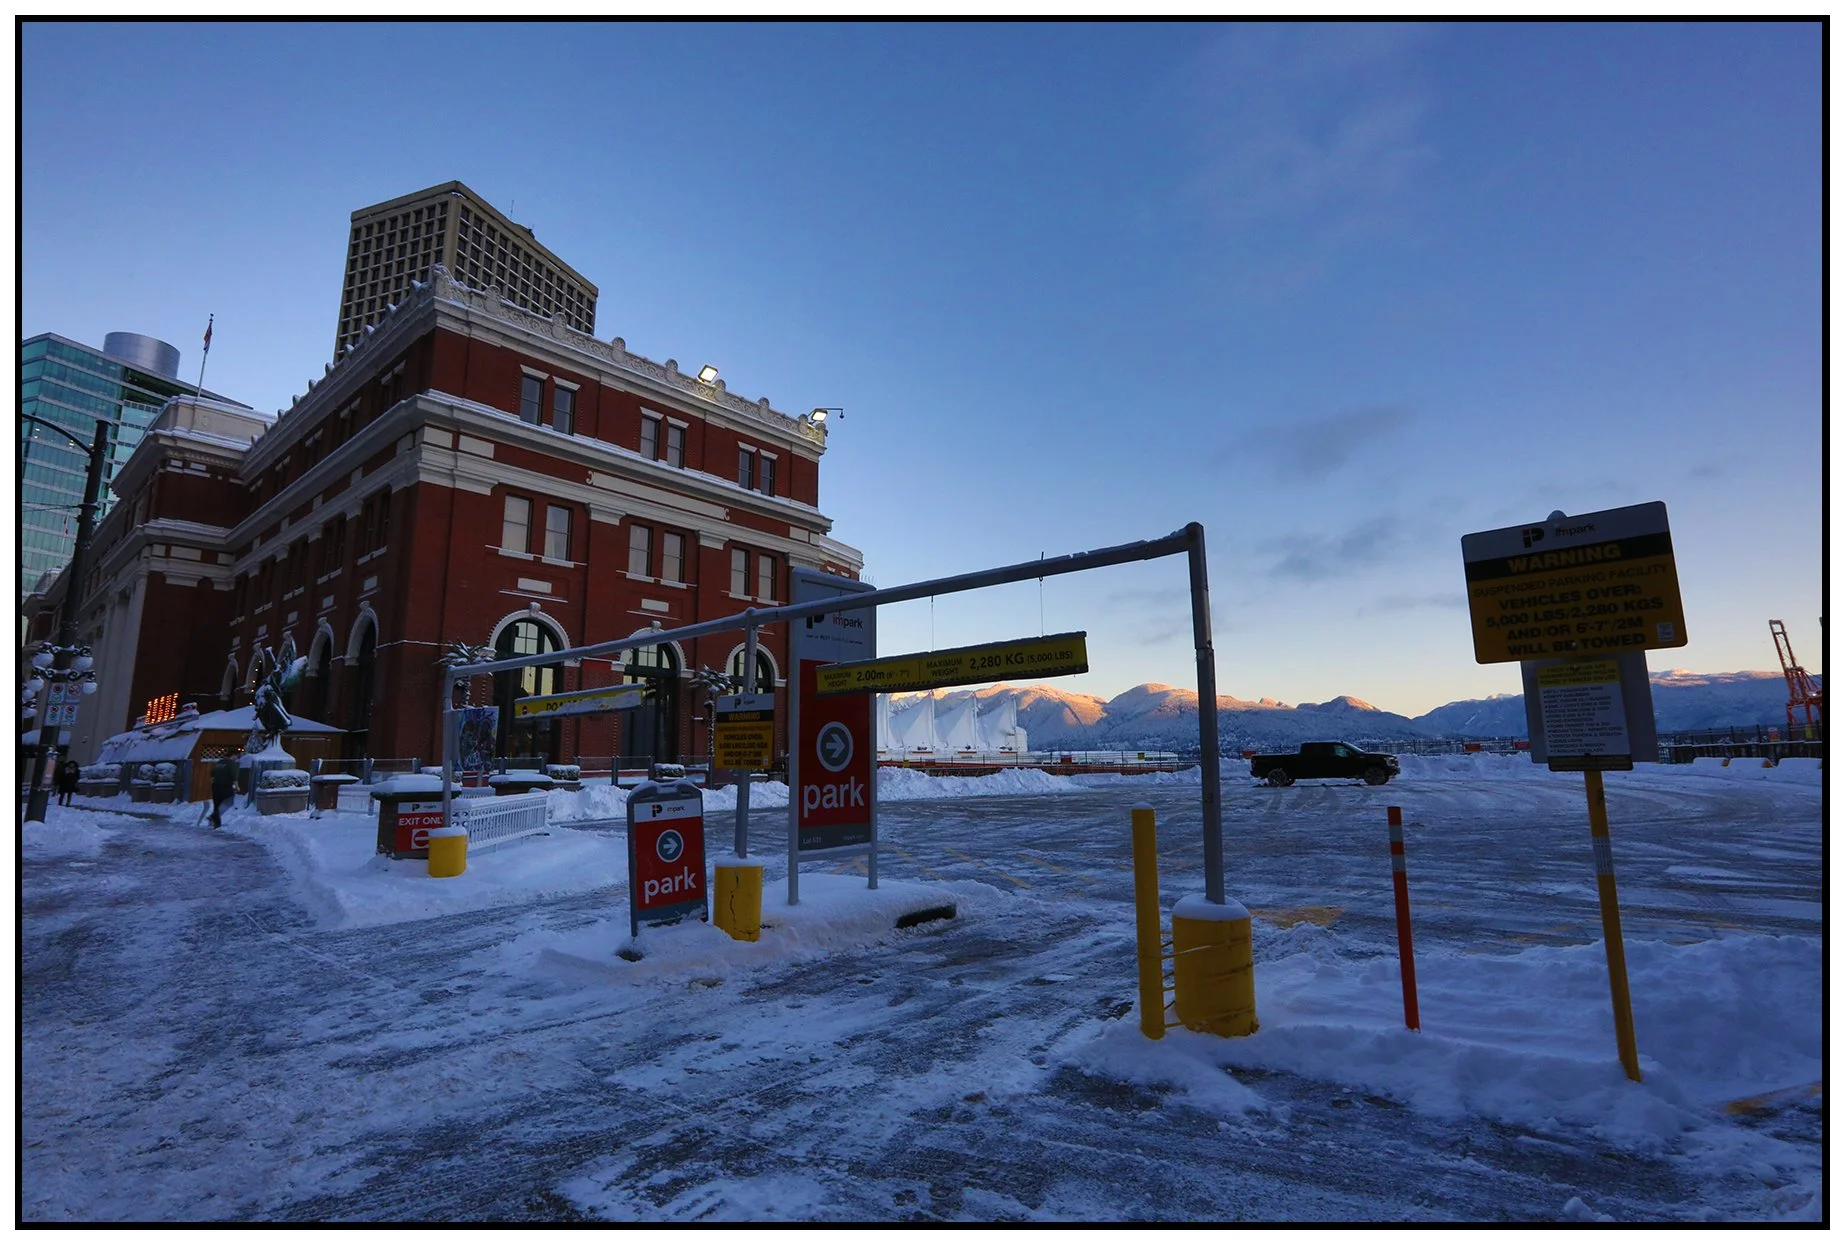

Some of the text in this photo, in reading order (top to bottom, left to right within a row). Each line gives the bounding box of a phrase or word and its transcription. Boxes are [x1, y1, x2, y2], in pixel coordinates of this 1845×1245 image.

[1555, 523, 1596, 537] impark
[1507, 543, 1622, 574] WARNING
[1474, 563, 1669, 598] SUSPENDED PARKING FACILITY
[1499, 584, 1643, 611] VEHICLES OVER:
[832, 613, 863, 629] impark
[1486, 597, 1663, 628] 5,000 LBS/2,280 KGS
[1507, 622, 1571, 641] AND/OR
[1507, 633, 1646, 656] WILL BE TOWED
[926, 657, 962, 669] MAXIMUM
[969, 650, 1073, 670] 2,280 KG (5,000 LBS)
[824, 671, 851, 681] MAXIMUM
[857, 670, 885, 682] 2.00m
[931, 667, 959, 677] WEIGHT
[827, 680, 847, 688] HEIGHT
[728, 711, 761, 721] WARNING
[803, 775, 865, 819] park
[398, 817, 421, 826] EXIT
[644, 865, 697, 905] park
